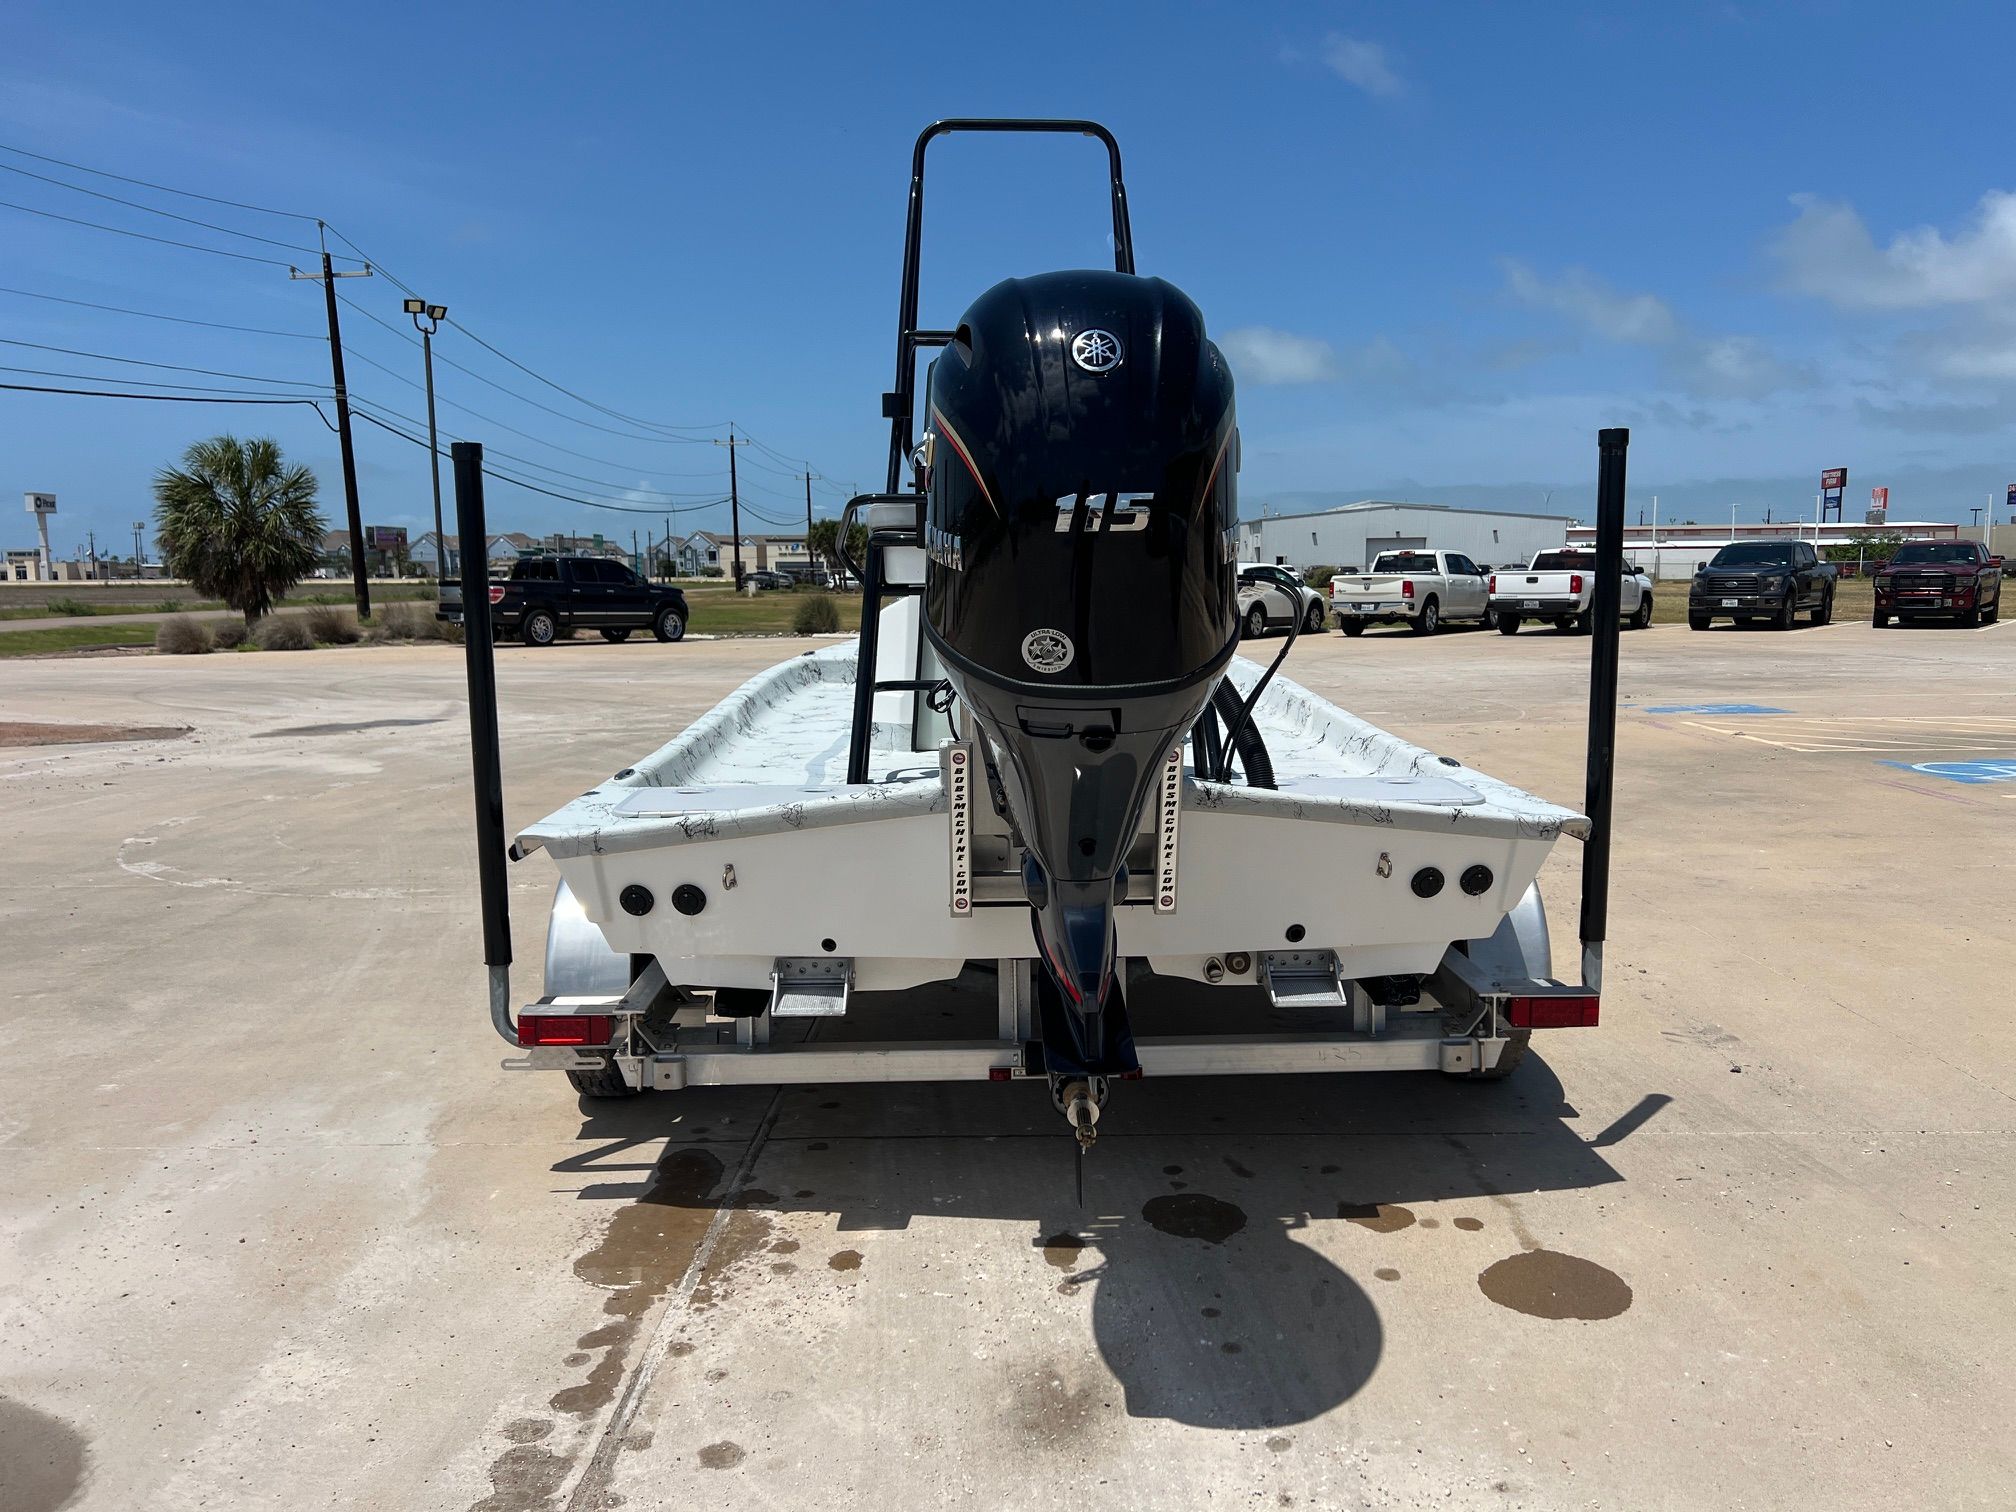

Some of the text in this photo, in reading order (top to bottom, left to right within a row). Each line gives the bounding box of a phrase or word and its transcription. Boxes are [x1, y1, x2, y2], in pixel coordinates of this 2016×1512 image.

[1055, 493, 1154, 532] 115
[1030, 629, 1067, 641] ULTRA LOW
